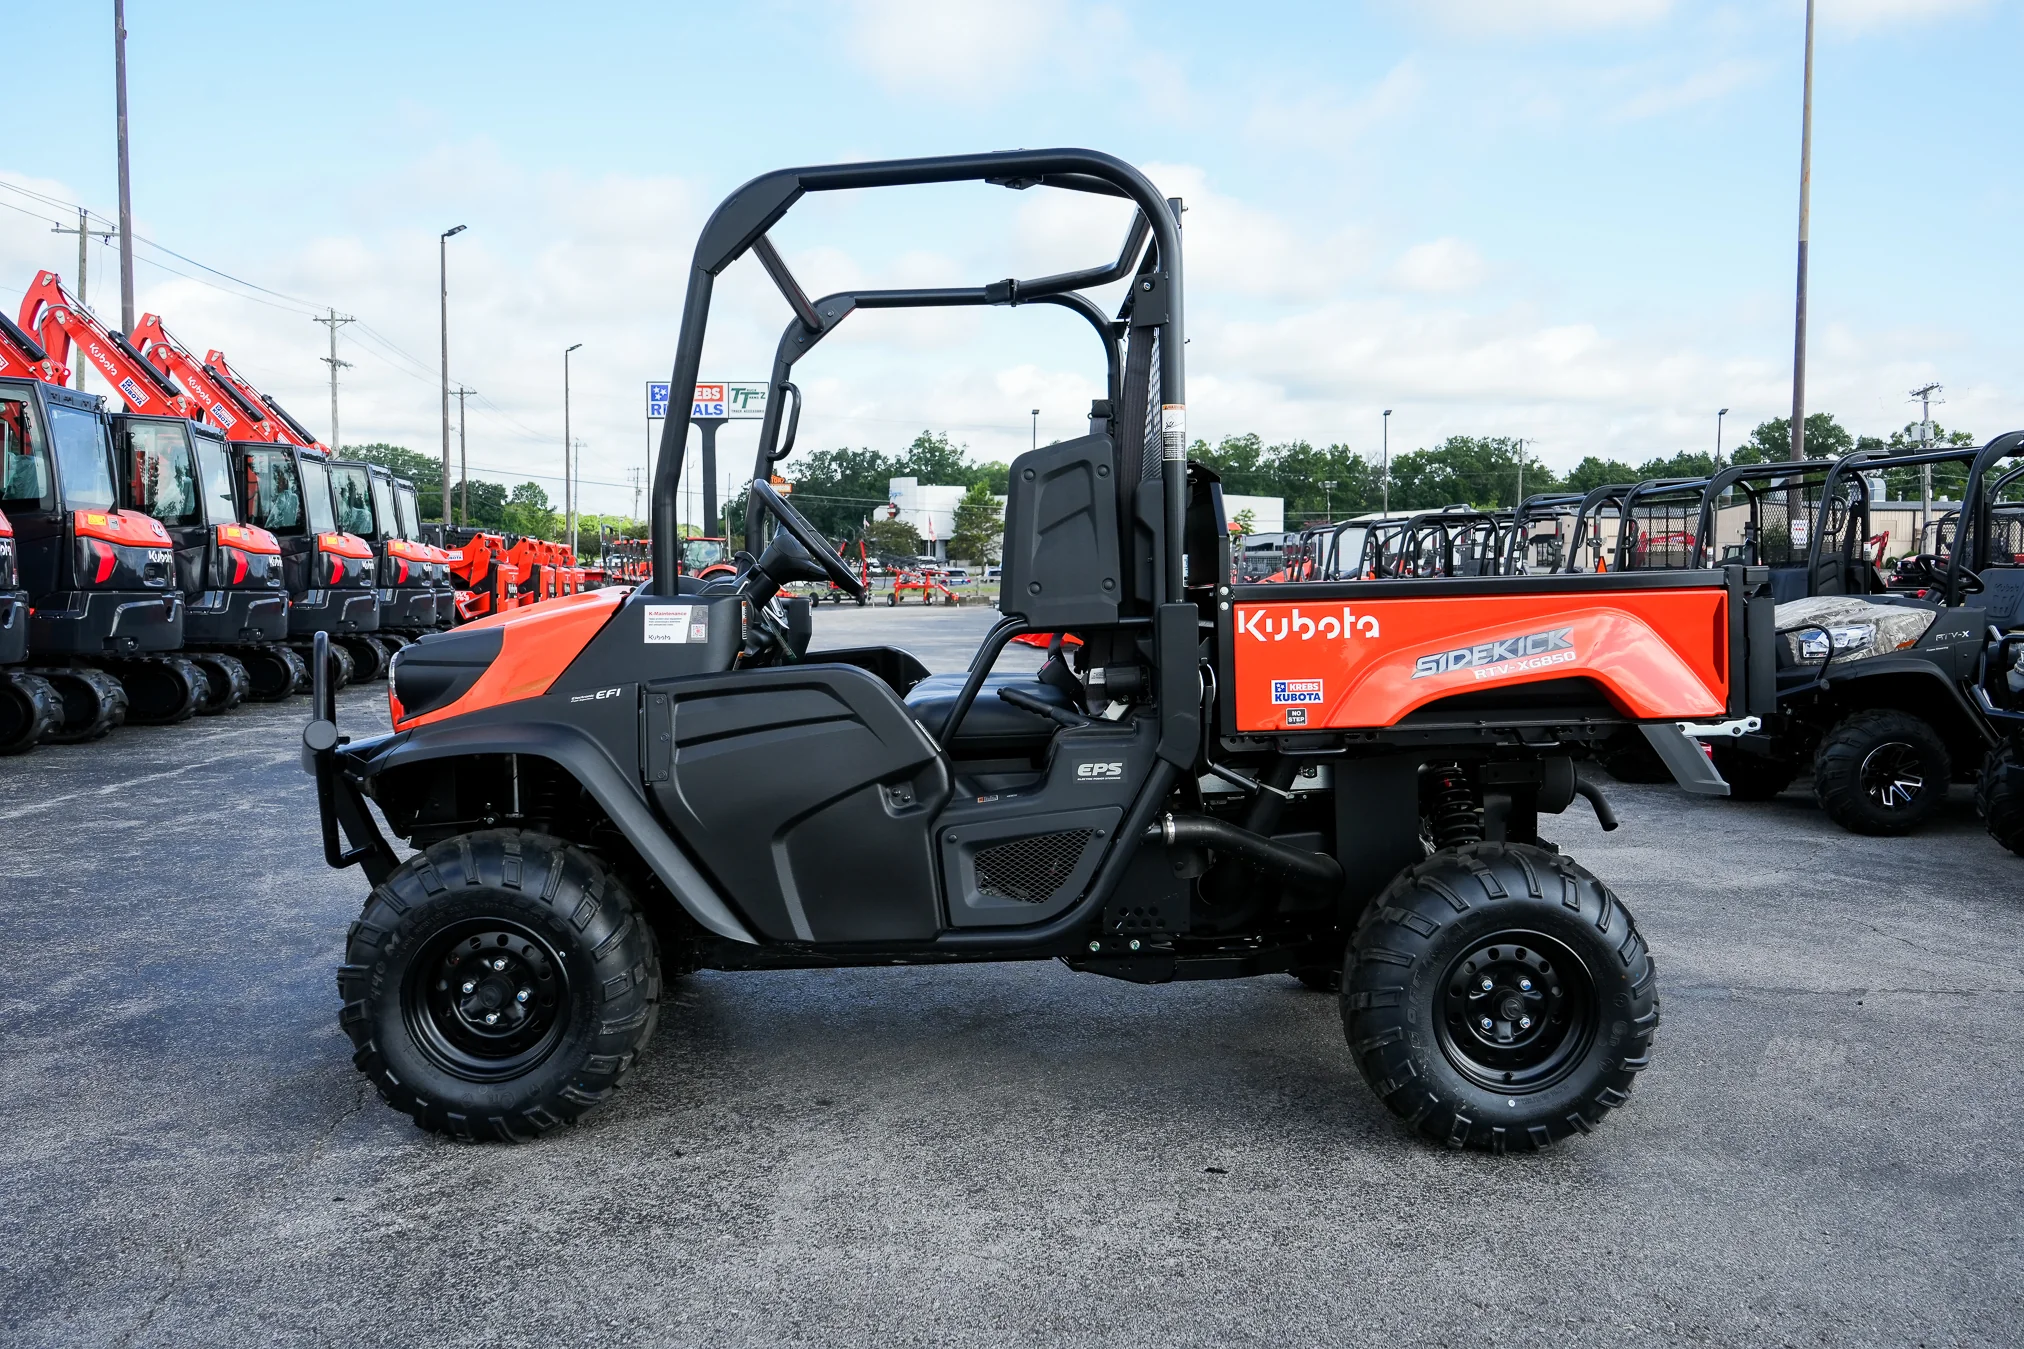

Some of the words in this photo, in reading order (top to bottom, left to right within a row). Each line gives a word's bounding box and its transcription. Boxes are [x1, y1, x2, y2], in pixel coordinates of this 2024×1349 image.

[89, 342, 118, 377] Kubota
[121, 383, 143, 406] KUBOTA
[187, 375, 212, 406] Kubota
[212, 407, 232, 428] KUBOTA
[1238, 607, 1380, 642] Kubota
[1411, 627, 1574, 680] SIDEKICK
[1474, 651, 1577, 680] RTV-XG850
[596, 688, 621, 699] EFI
[1275, 692, 1321, 702] KUBOTA
[1289, 683, 1319, 691] KREBS
[1078, 762, 1123, 776] EPS
